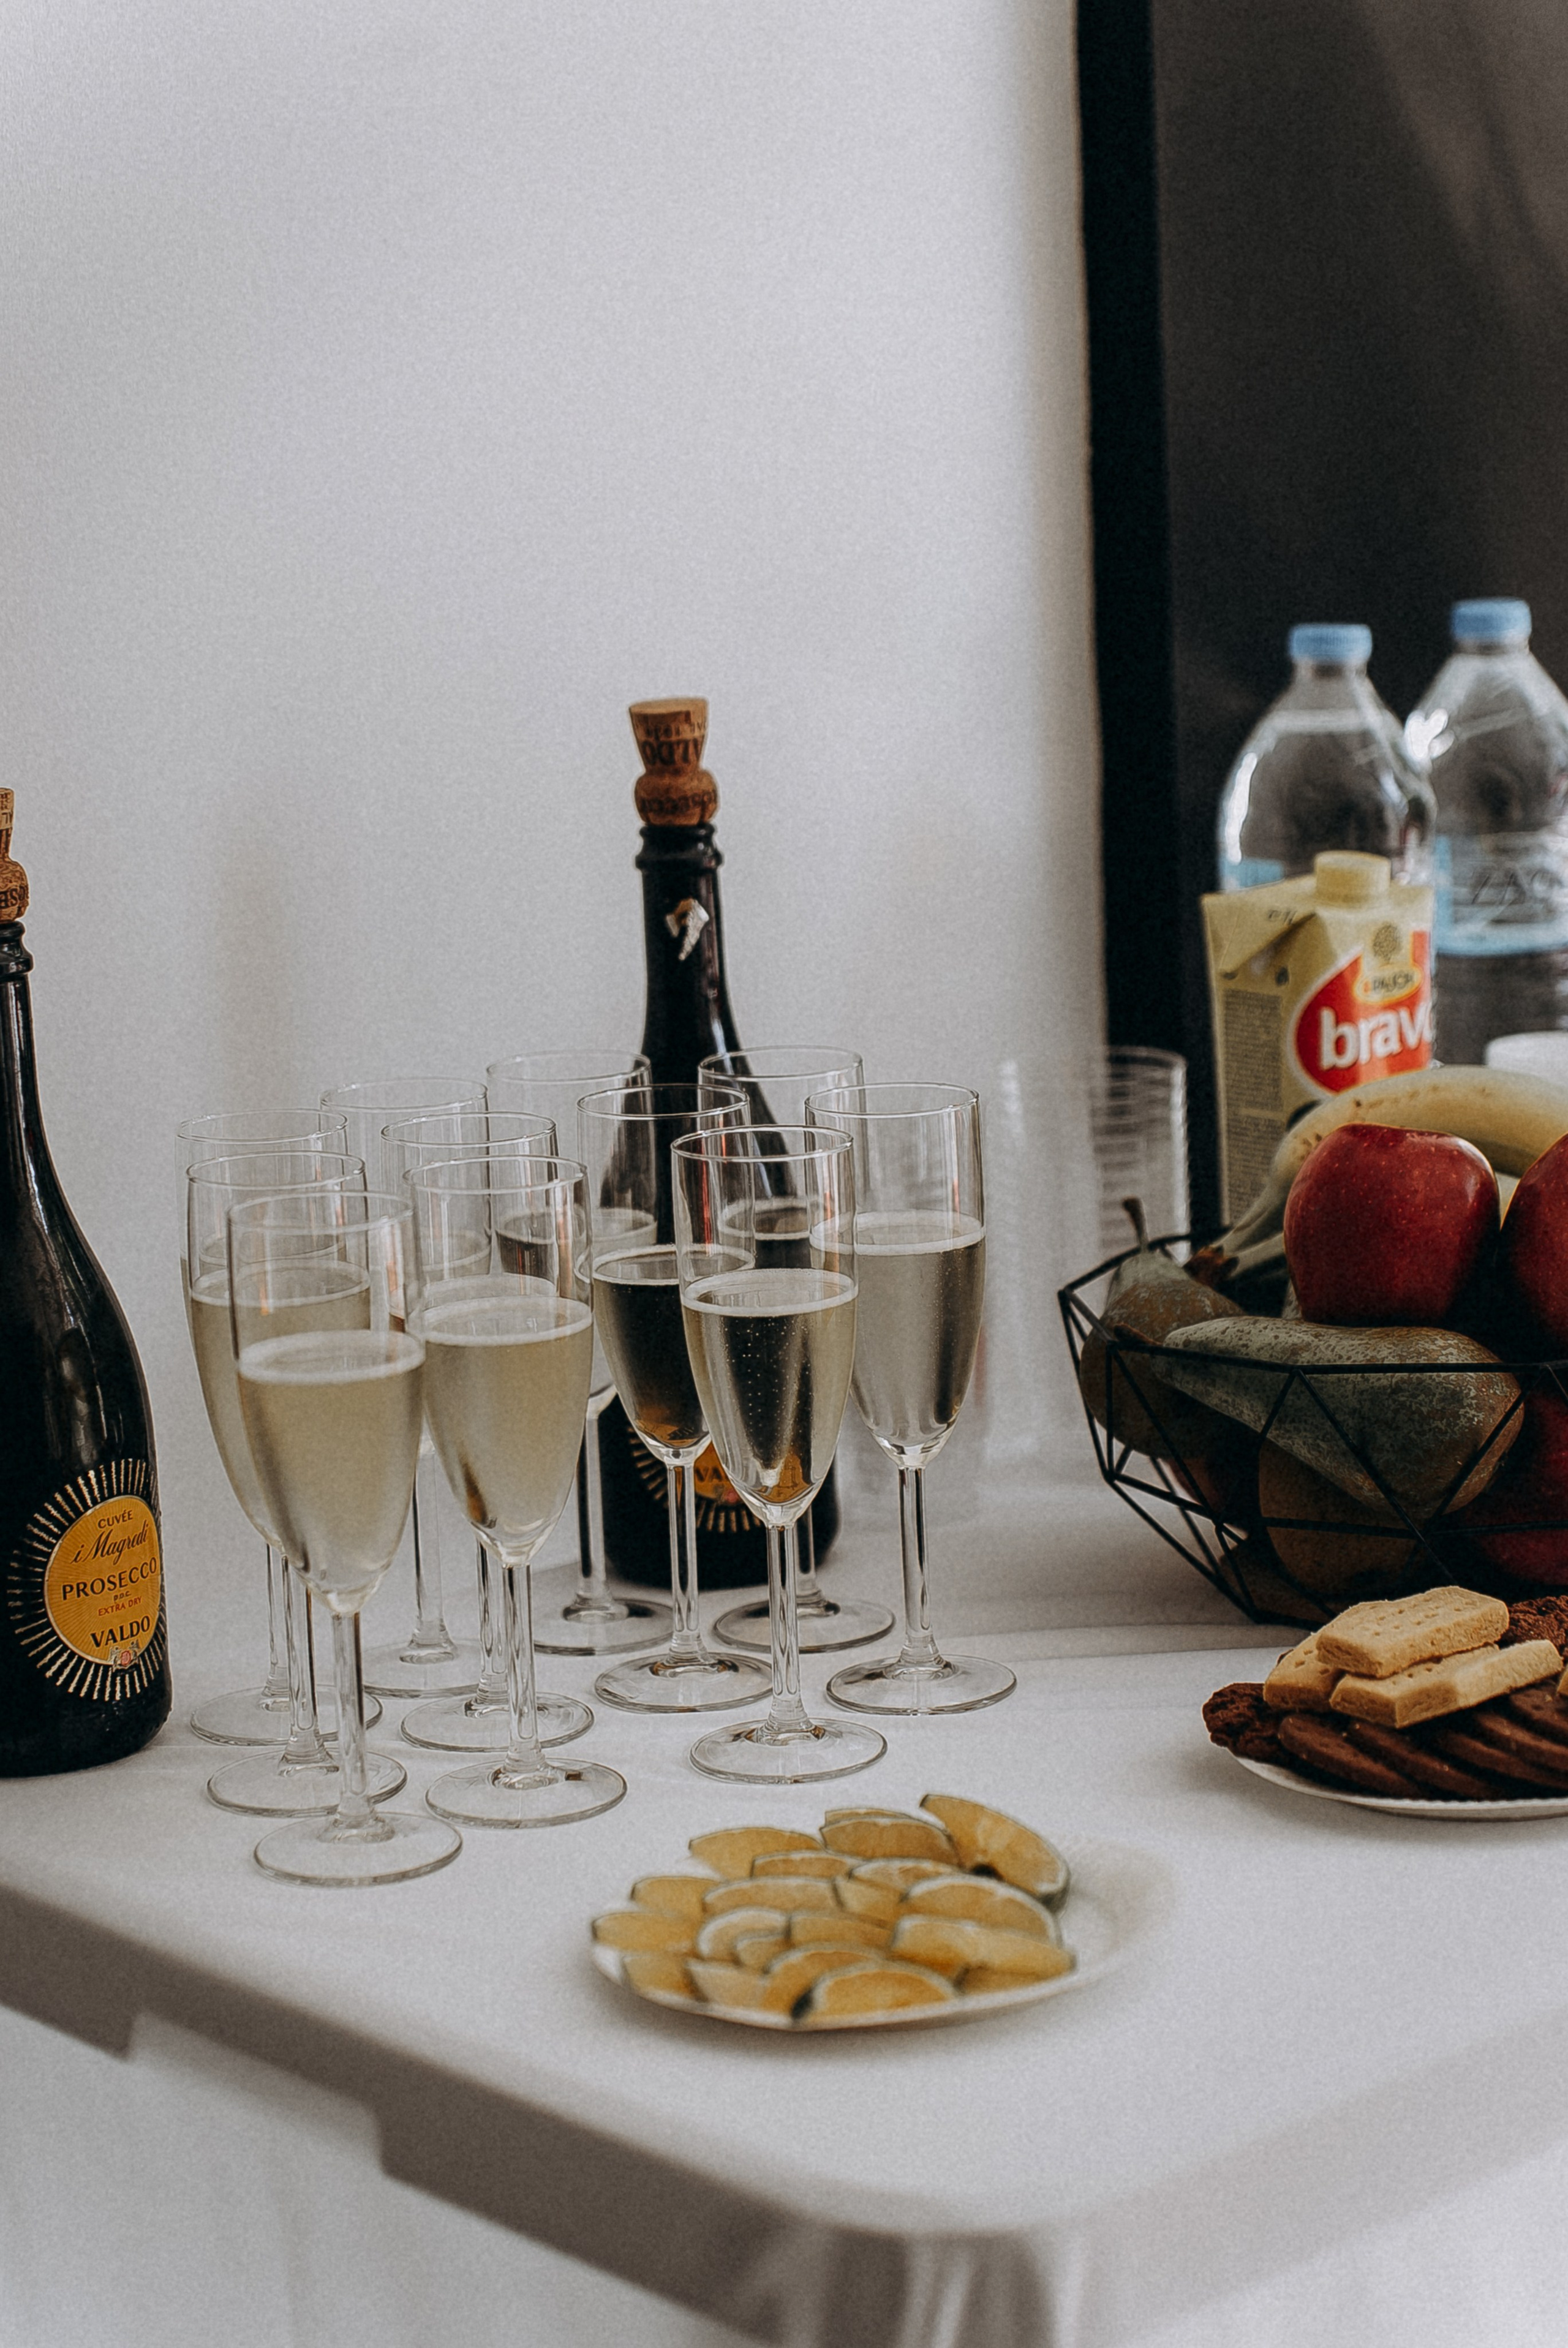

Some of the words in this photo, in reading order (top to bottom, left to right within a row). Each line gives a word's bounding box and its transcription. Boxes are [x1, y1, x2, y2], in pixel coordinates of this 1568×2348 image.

[98, 1509, 133, 1529] CUVÉE
[82, 1519, 149, 1566] Magredi
[62, 1557, 157, 1601] PROSECCO
[98, 1602, 126, 1617] EXTRA
[128, 1596, 141, 1608] DRY
[90, 1615, 151, 1648] VALDO
